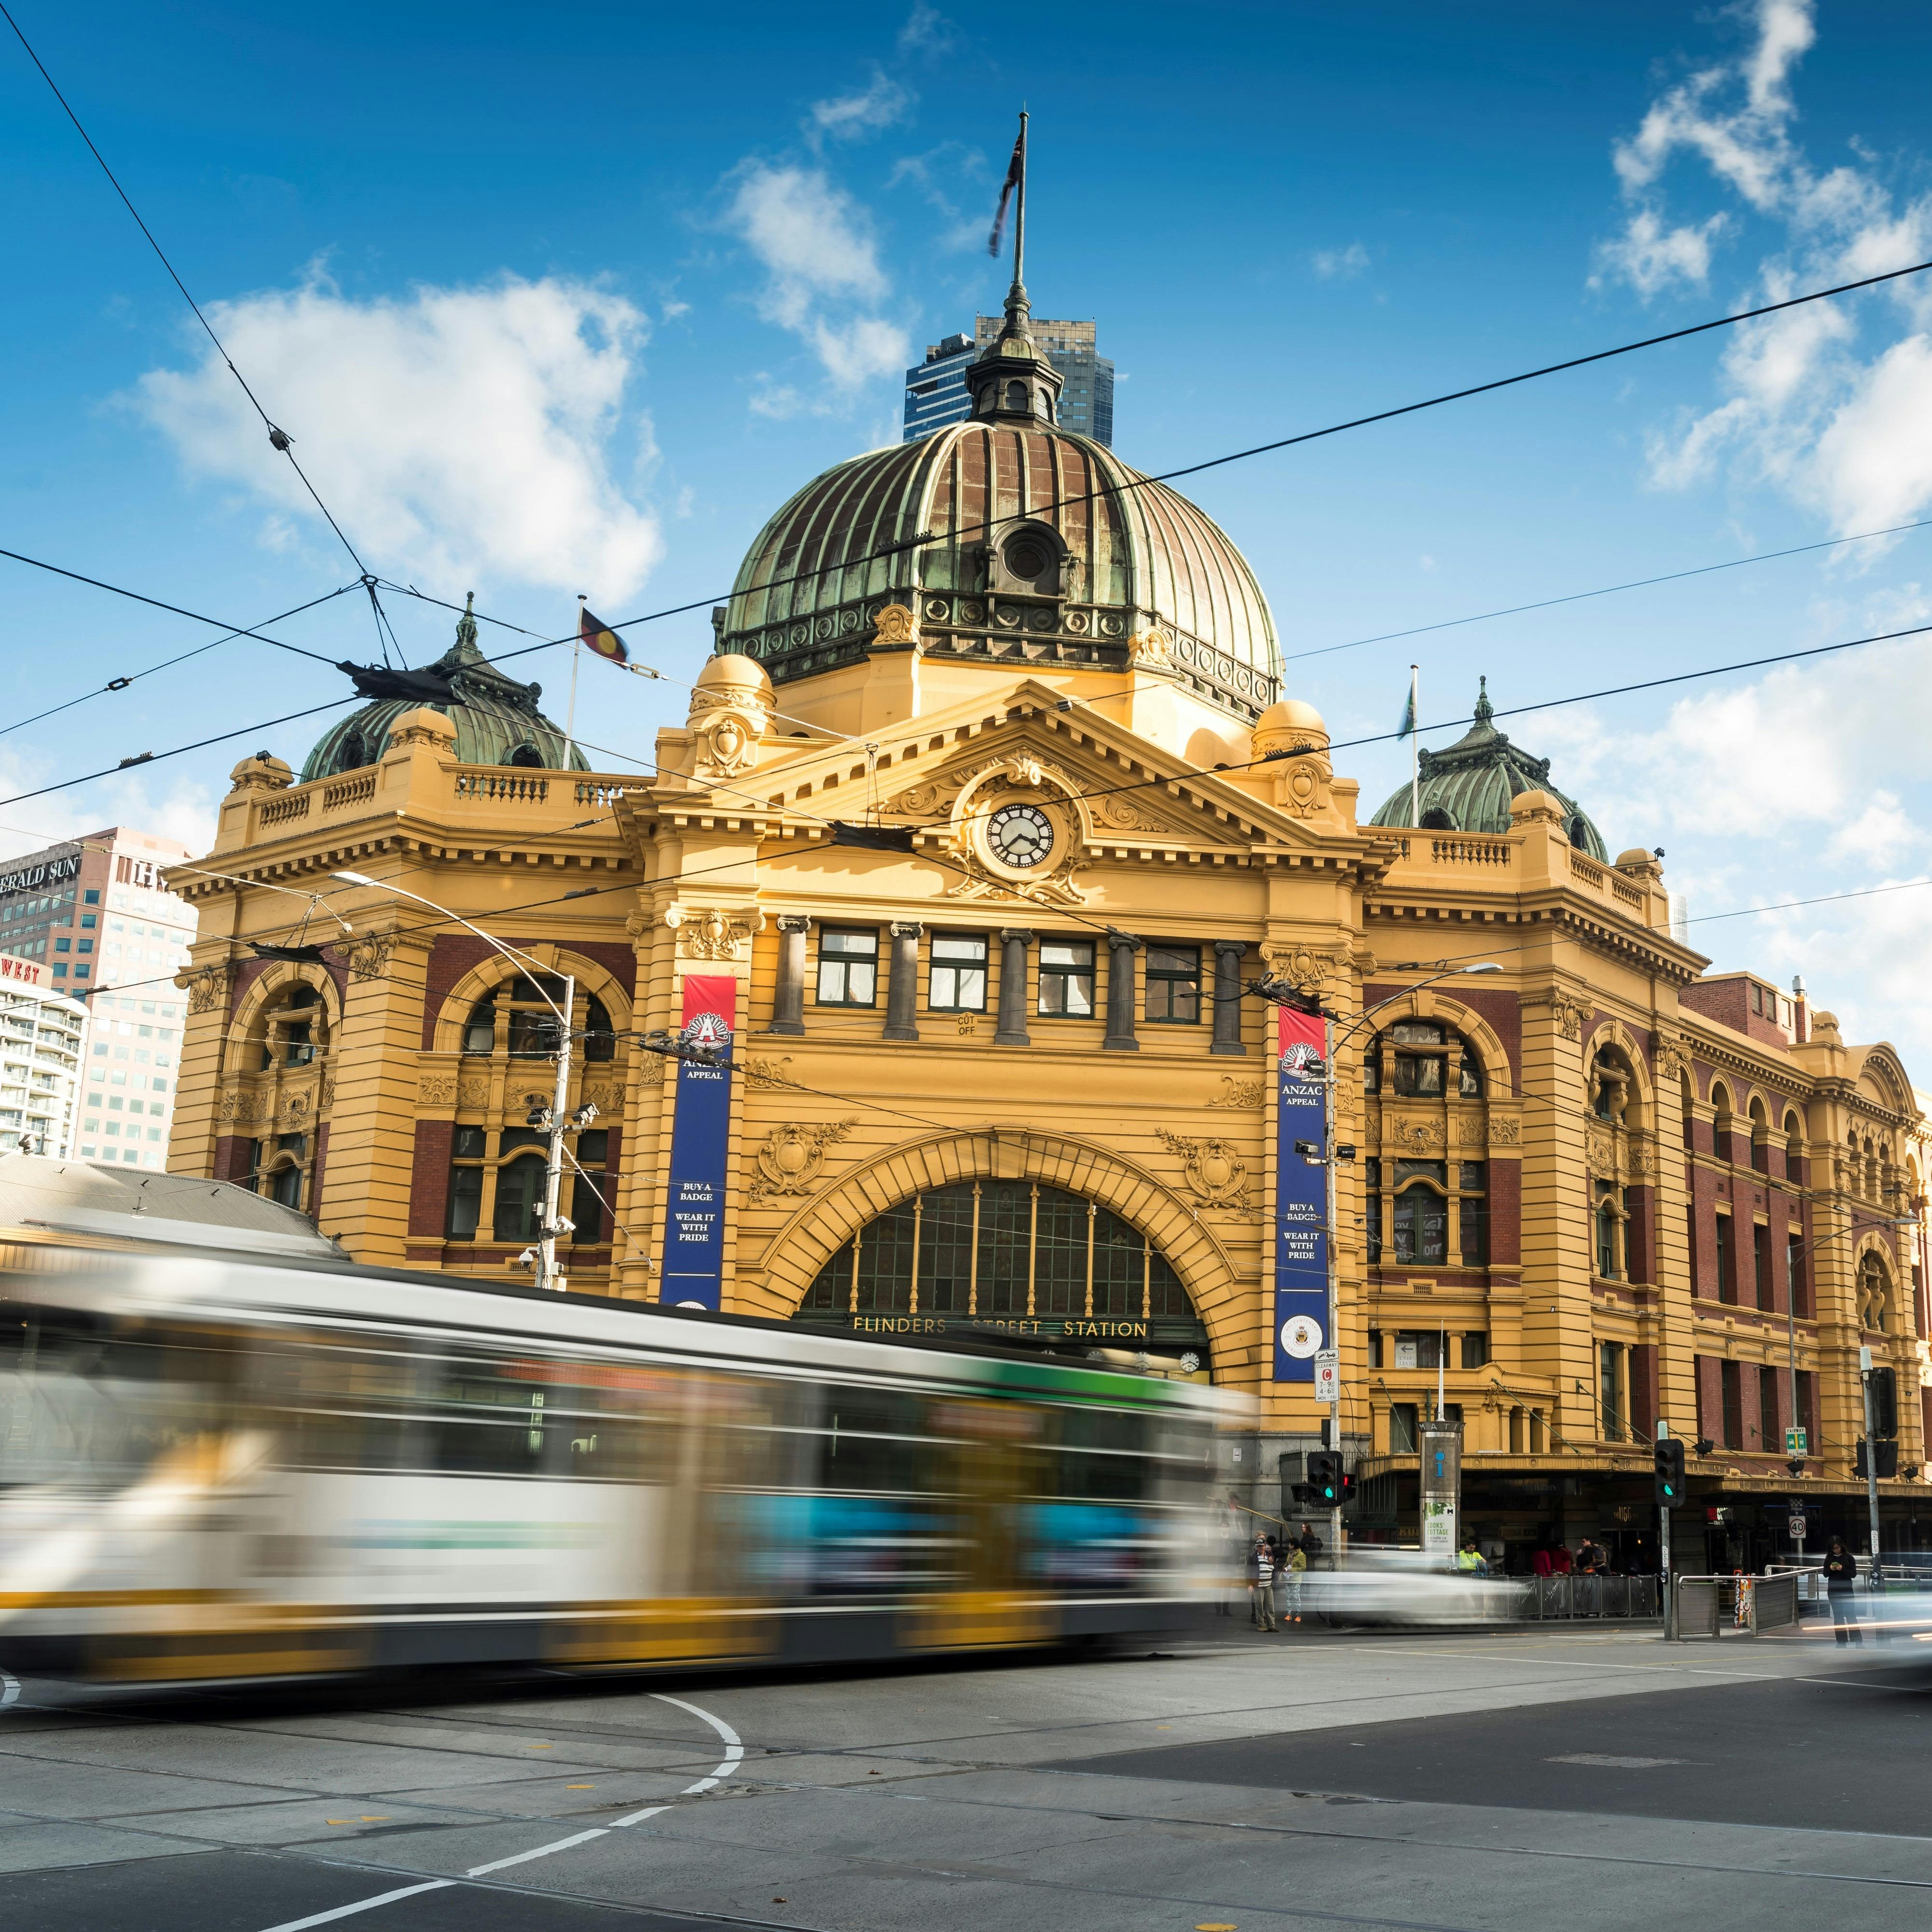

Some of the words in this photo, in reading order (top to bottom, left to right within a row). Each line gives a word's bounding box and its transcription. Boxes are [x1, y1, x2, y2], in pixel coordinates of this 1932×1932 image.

[49, 856, 79, 881] SUN
[1, 958, 40, 984] WEST
[958, 1016, 975, 1025] CUT
[959, 1026, 975, 1035] OFF
[687, 1071, 723, 1079] APPEAL
[1282, 1085, 1322, 1095] ANZAC
[680, 1193, 713, 1201] BADGE
[679, 1233, 709, 1242] PRIDE
[854, 1317, 946, 1333] FLINDERS
[1064, 1321, 1146, 1337] STATION
[1293, 1319, 1318, 1331] CENTENARY
[1286, 1343, 1305, 1355] SERVING
[1307, 1344, 1318, 1354] STILL
[1324, 1369, 1330, 1380] C
[1619, 1506, 1631, 1522] UGG
[1792, 1523, 1804, 1531] 40
